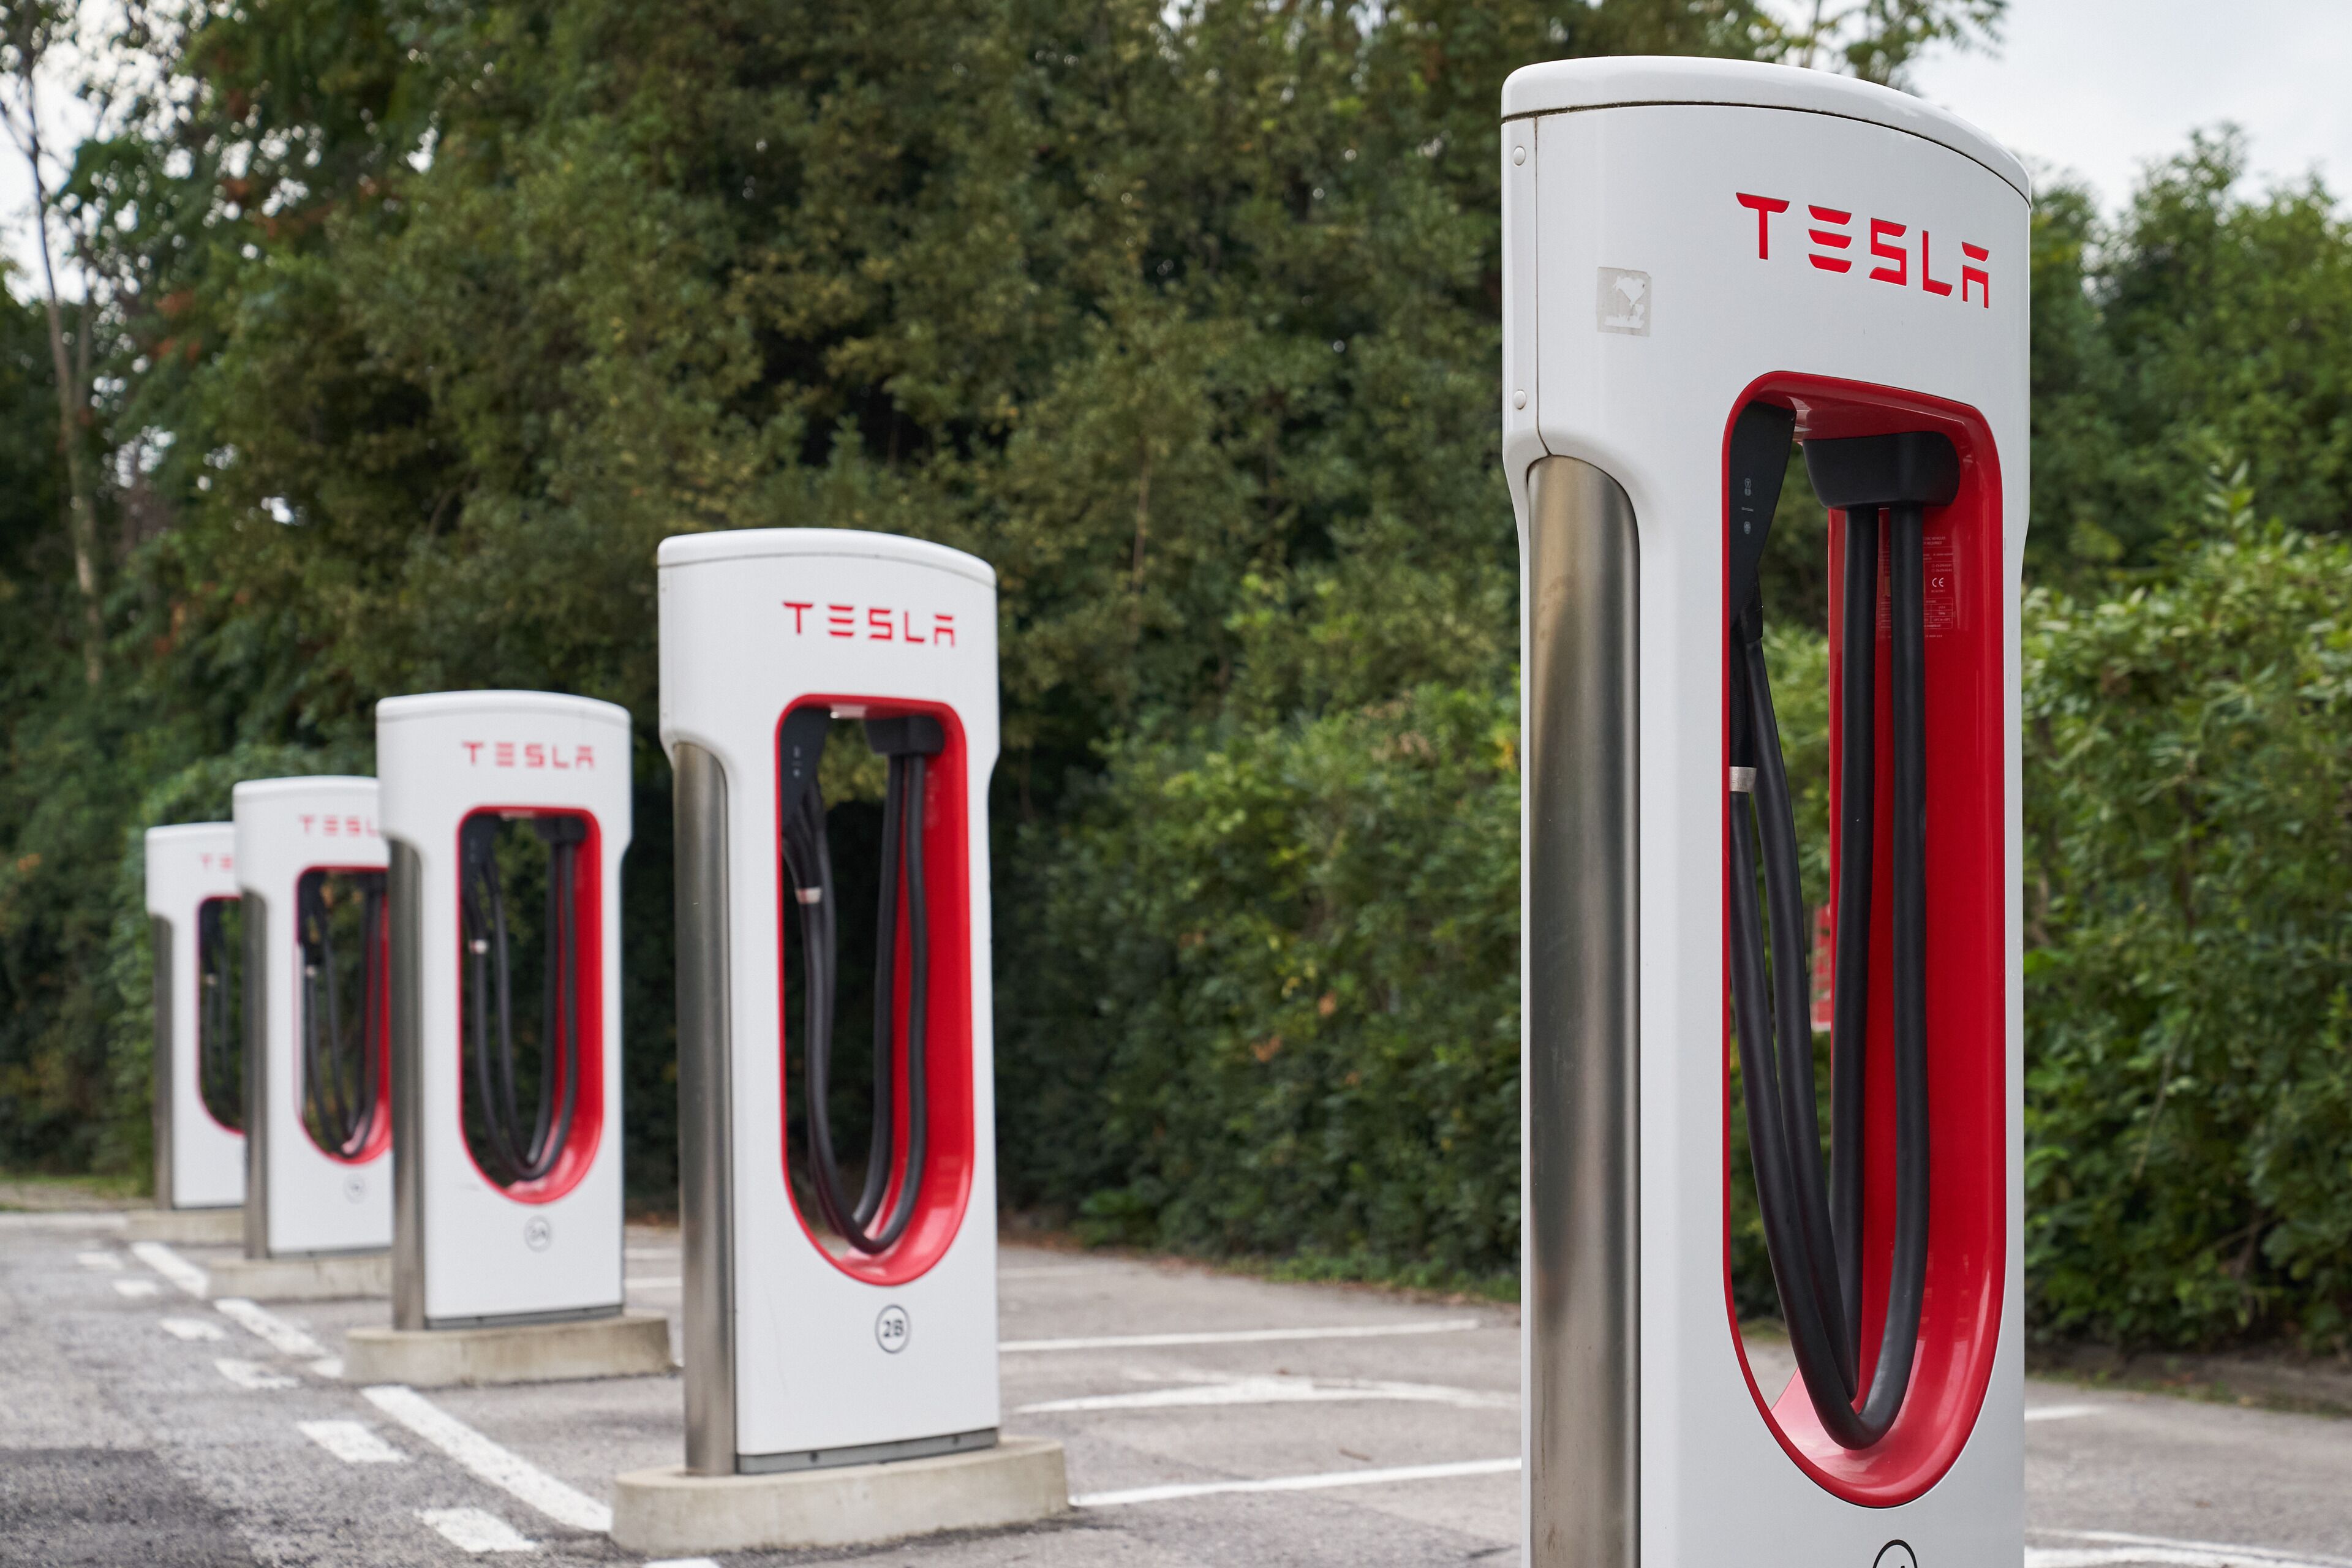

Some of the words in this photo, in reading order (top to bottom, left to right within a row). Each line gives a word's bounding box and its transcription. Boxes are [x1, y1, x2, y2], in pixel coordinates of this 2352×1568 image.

[1736, 192, 1990, 309] TESLA
[782, 601, 956, 648] TESLA
[462, 741, 595, 769] TESLA
[300, 815, 378, 838] TESL
